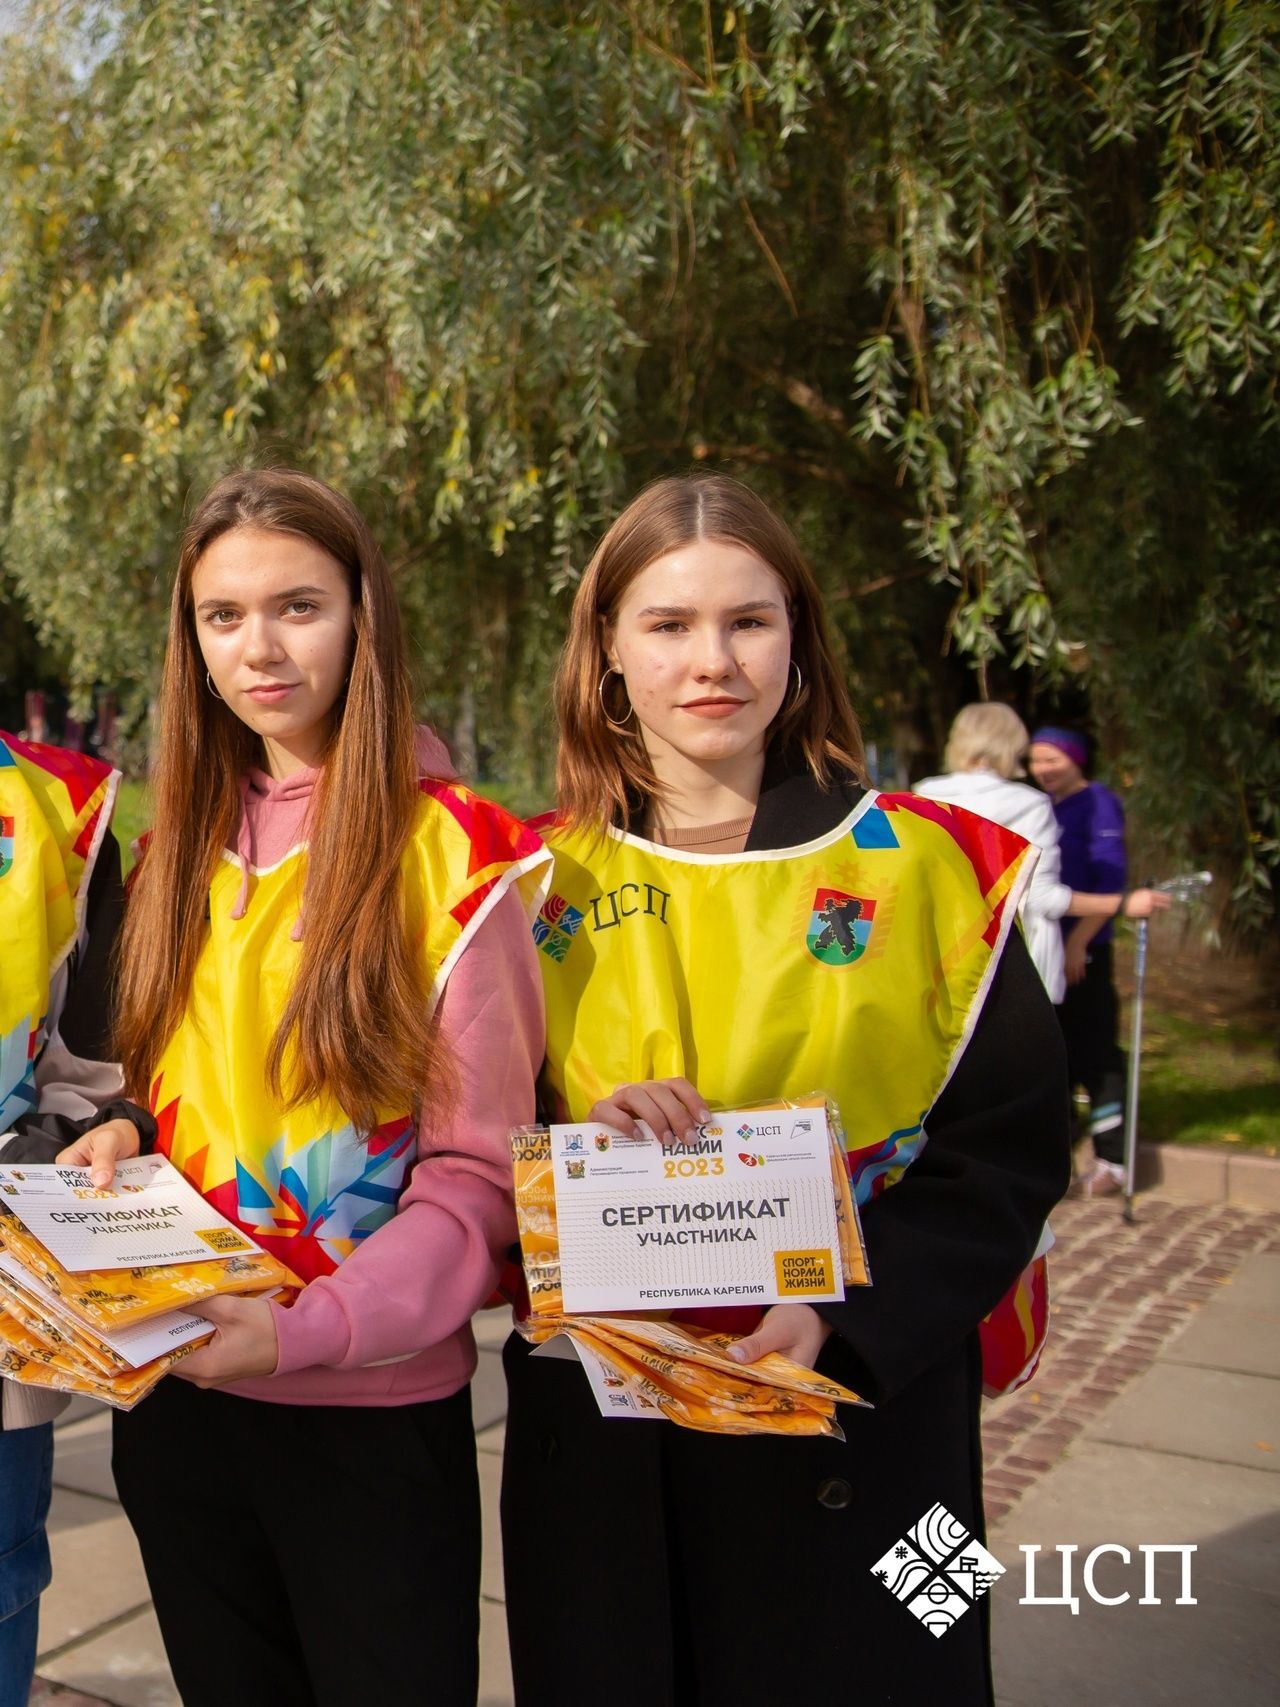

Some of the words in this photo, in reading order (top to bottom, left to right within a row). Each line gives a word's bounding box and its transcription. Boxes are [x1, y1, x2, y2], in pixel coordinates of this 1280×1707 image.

[589, 883, 671, 931] ЦСП
[756, 1126, 782, 1136] ЦСП
[664, 1158, 725, 1178] 2023
[73, 1188, 119, 1200] 2023
[50, 1205, 183, 1224] СЕРТИФИКАТ
[602, 1198, 790, 1226] СЕРТИФИКАТ
[86, 1220, 176, 1235] УЧАСТНИКА
[209, 1236, 239, 1244] НОРМА
[637, 1228, 757, 1246] УЧАСТНИКА
[217, 1241, 244, 1249] ЖИЗНИ
[117, 1253, 168, 1261] РЕСПУБЛИКА
[169, 1248, 207, 1256] КАРЕЛИЯ
[782, 1257, 816, 1268] СПОРТ
[784, 1267, 825, 1278] НОРМА
[785, 1277, 826, 1288] ЖИЗНИ
[639, 1288, 712, 1298] РЕСПУБЛИКА
[713, 1285, 765, 1295] КАРЕЛИЯ
